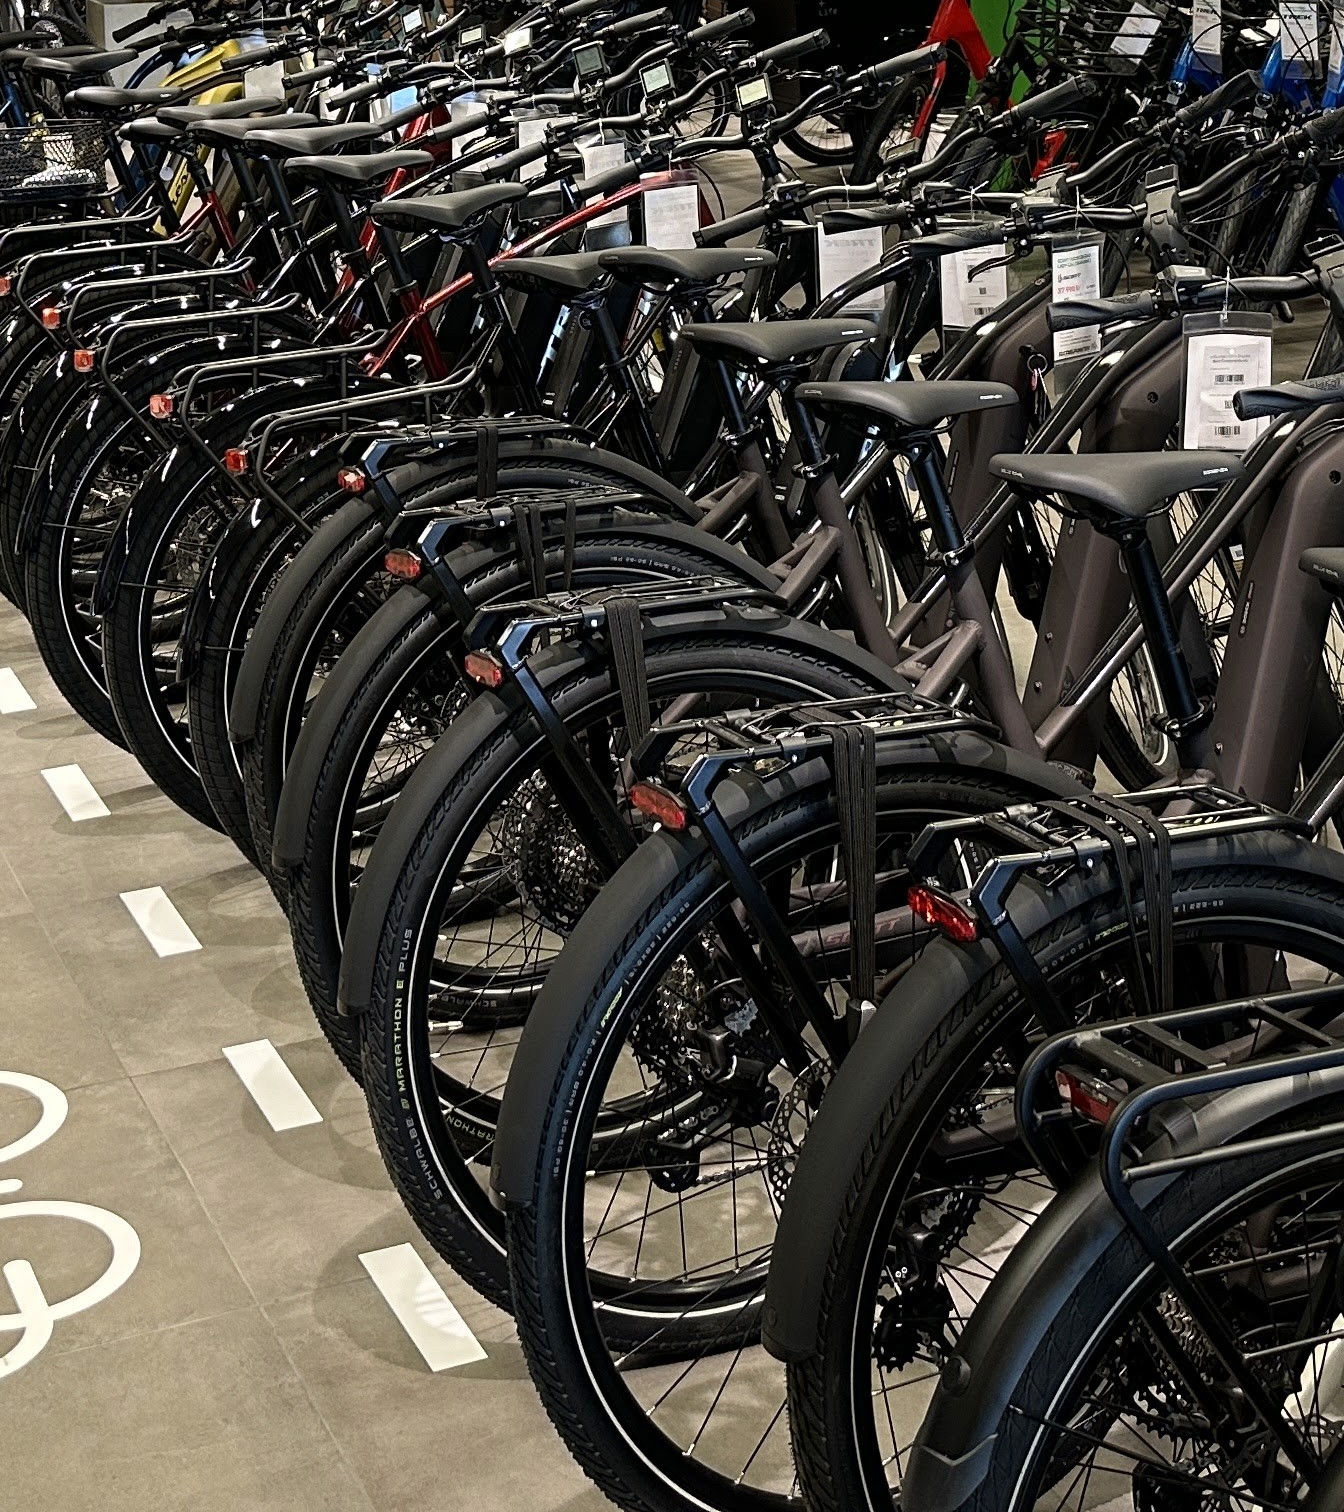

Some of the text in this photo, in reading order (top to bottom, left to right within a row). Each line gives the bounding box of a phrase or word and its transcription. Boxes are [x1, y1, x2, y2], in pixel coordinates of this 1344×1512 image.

[394, 928, 443, 1201] SCHWALBE MARATHON PLUS
[446, 1115, 496, 1141] RATHON
